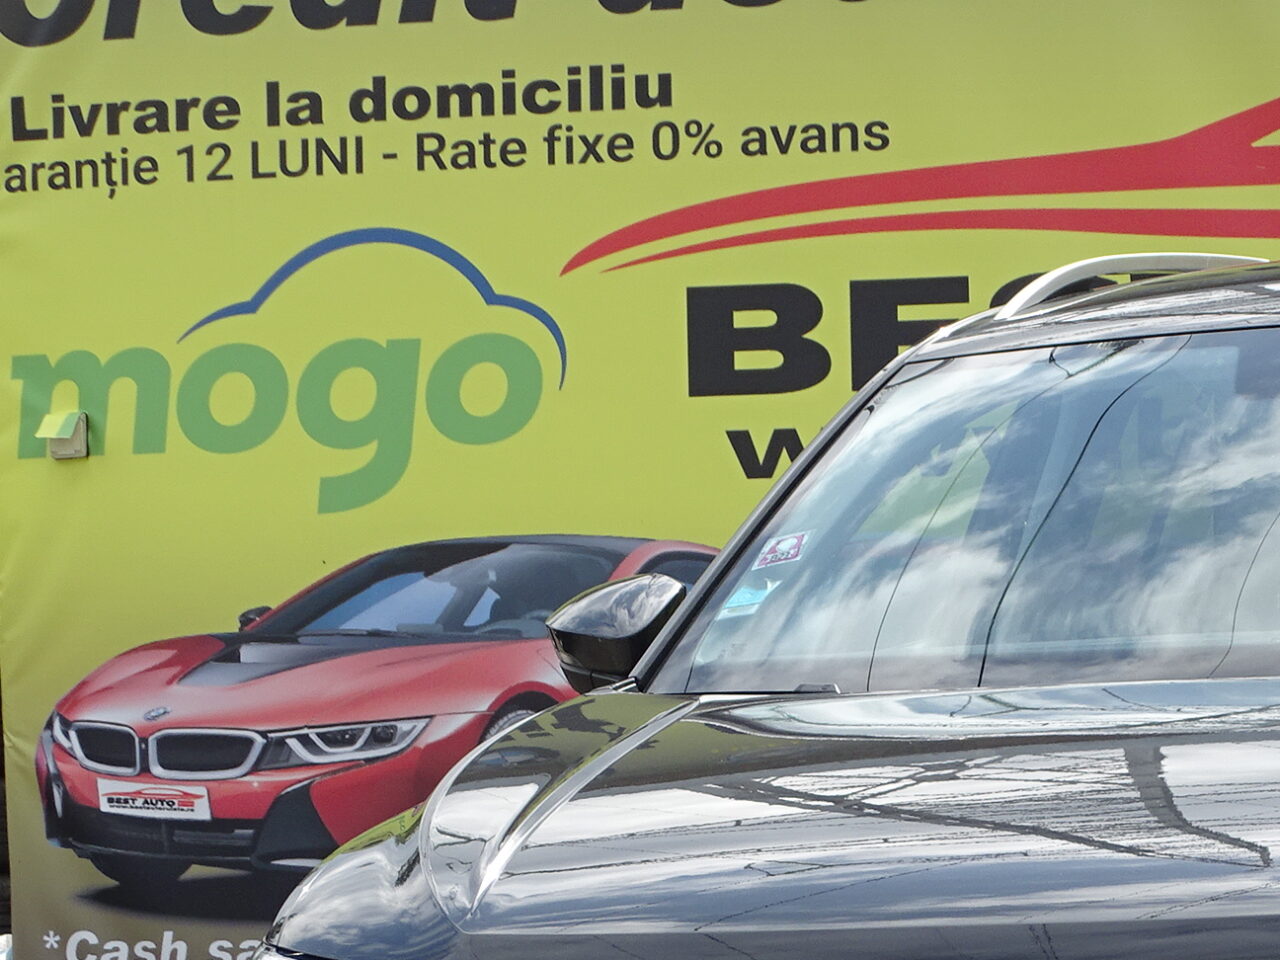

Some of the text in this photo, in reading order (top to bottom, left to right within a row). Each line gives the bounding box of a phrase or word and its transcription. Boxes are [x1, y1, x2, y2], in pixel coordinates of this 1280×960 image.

[11, 64, 673, 142] Livrare la domiciliu
[176, 142, 233, 183] 12
[251, 135, 364, 179] LUNI
[416, 131, 527, 171] Rate
[542, 124, 635, 166] fixe
[652, 119, 723, 161] 0%
[740, 119, 890, 157] avans
[686, 272, 1045, 397] BE
[11, 332, 543, 515] mogo
[107, 797, 138, 805] BEST
[142, 798, 176, 807] AUTO
